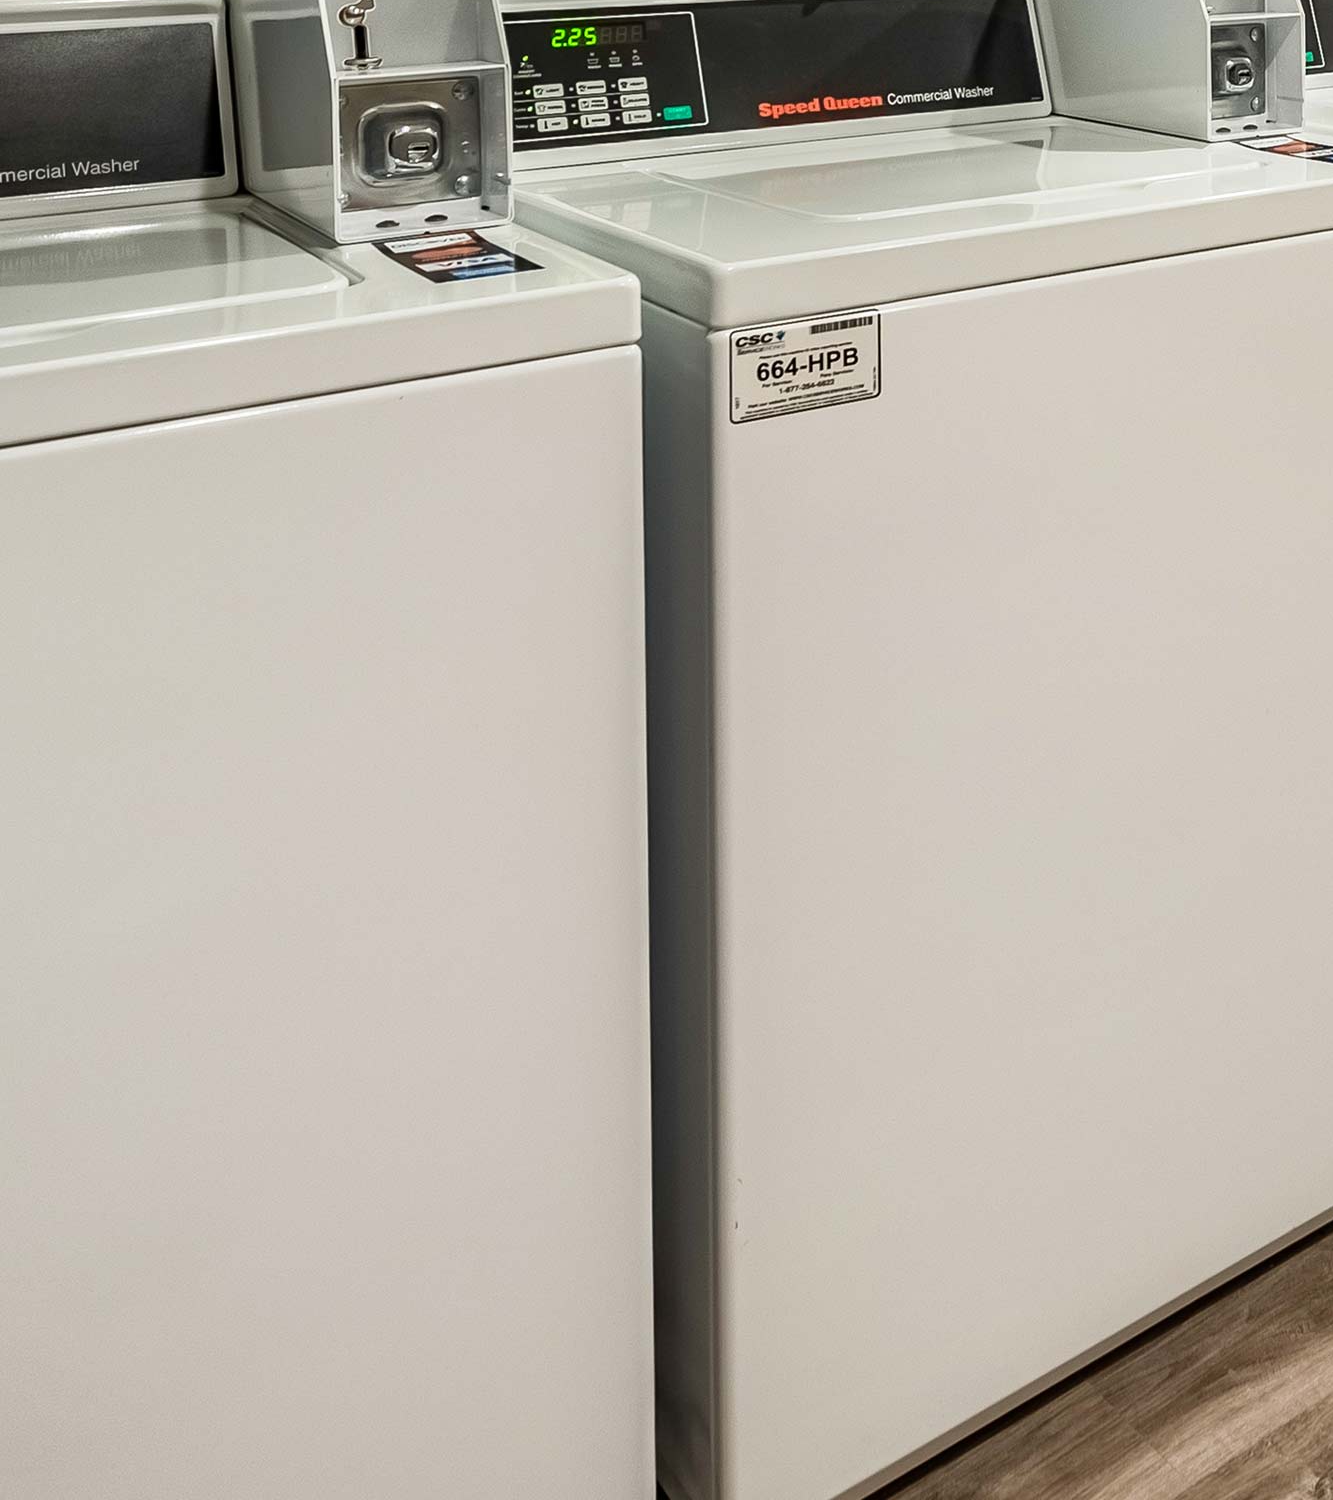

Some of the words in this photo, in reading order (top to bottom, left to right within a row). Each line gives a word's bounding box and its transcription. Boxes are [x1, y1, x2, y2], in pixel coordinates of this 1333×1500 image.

[551, 26, 597, 48] 2.25
[758, 97, 821, 119] Speed
[823, 95, 883, 111] Queen
[887, 89, 953, 106] Commercial
[954, 85, 995, 99] Washer
[0, 163, 66, 183] mercial
[71, 159, 140, 177] Washer
[735, 332, 774, 348] CSC
[757, 347, 859, 382] 664-HPB
